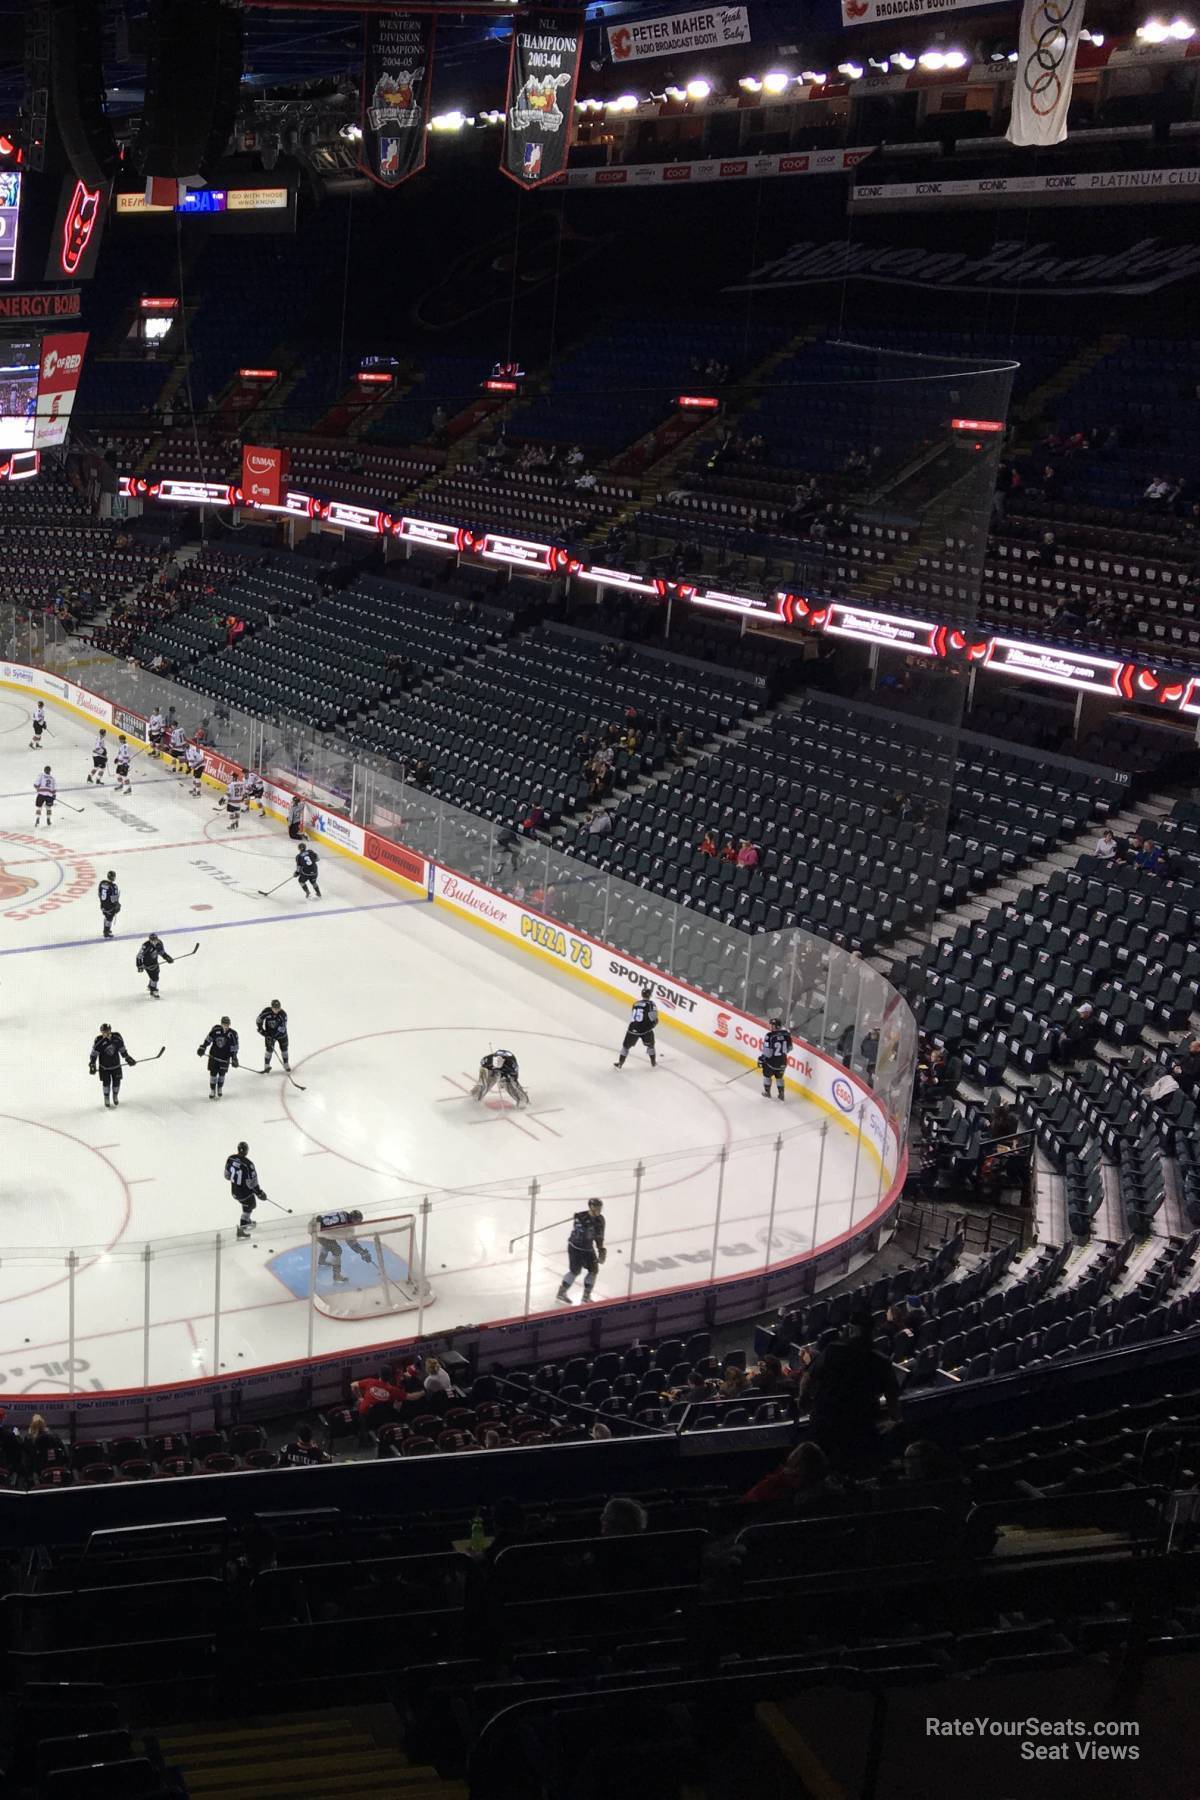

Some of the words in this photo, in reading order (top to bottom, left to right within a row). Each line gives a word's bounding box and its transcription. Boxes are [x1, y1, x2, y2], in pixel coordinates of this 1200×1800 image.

[876, 0, 924, 17] BROADCAST
[379, 20, 421, 31] WESTERN
[539, 19, 557, 31] NLL
[633, 24, 668, 41] PETER
[672, 14, 715, 38] MAHER
[380, 32, 420, 43] DIVISION
[517, 32, 576, 53] CHAMPIONS
[635, 42, 655, 55] RADIO
[655, 36, 693, 52] BROADCAST
[694, 32, 718, 46] BOOTH
[372, 44, 424, 55] CHAMPIONS
[528, 52, 561, 69] 2003-04
[1091, 172, 1162, 187] PLATINUM
[1169, 171, 1200, 185] CLU
[65, 354, 81, 370] RED
[252, 456, 275, 467] ENMAX
[842, 614, 914, 641] HitmenHockey.com
[1005, 649, 1095, 679] HitmenHockey.com
[441, 875, 507, 924] Budweiser
[520, 914, 567, 957] PIZZA
[569, 938, 593, 969] 73
[609, 960, 697, 1013] SPORTSNET
[626, 1241, 758, 1275] RAM
[30, 1358, 91, 1377] OIL
